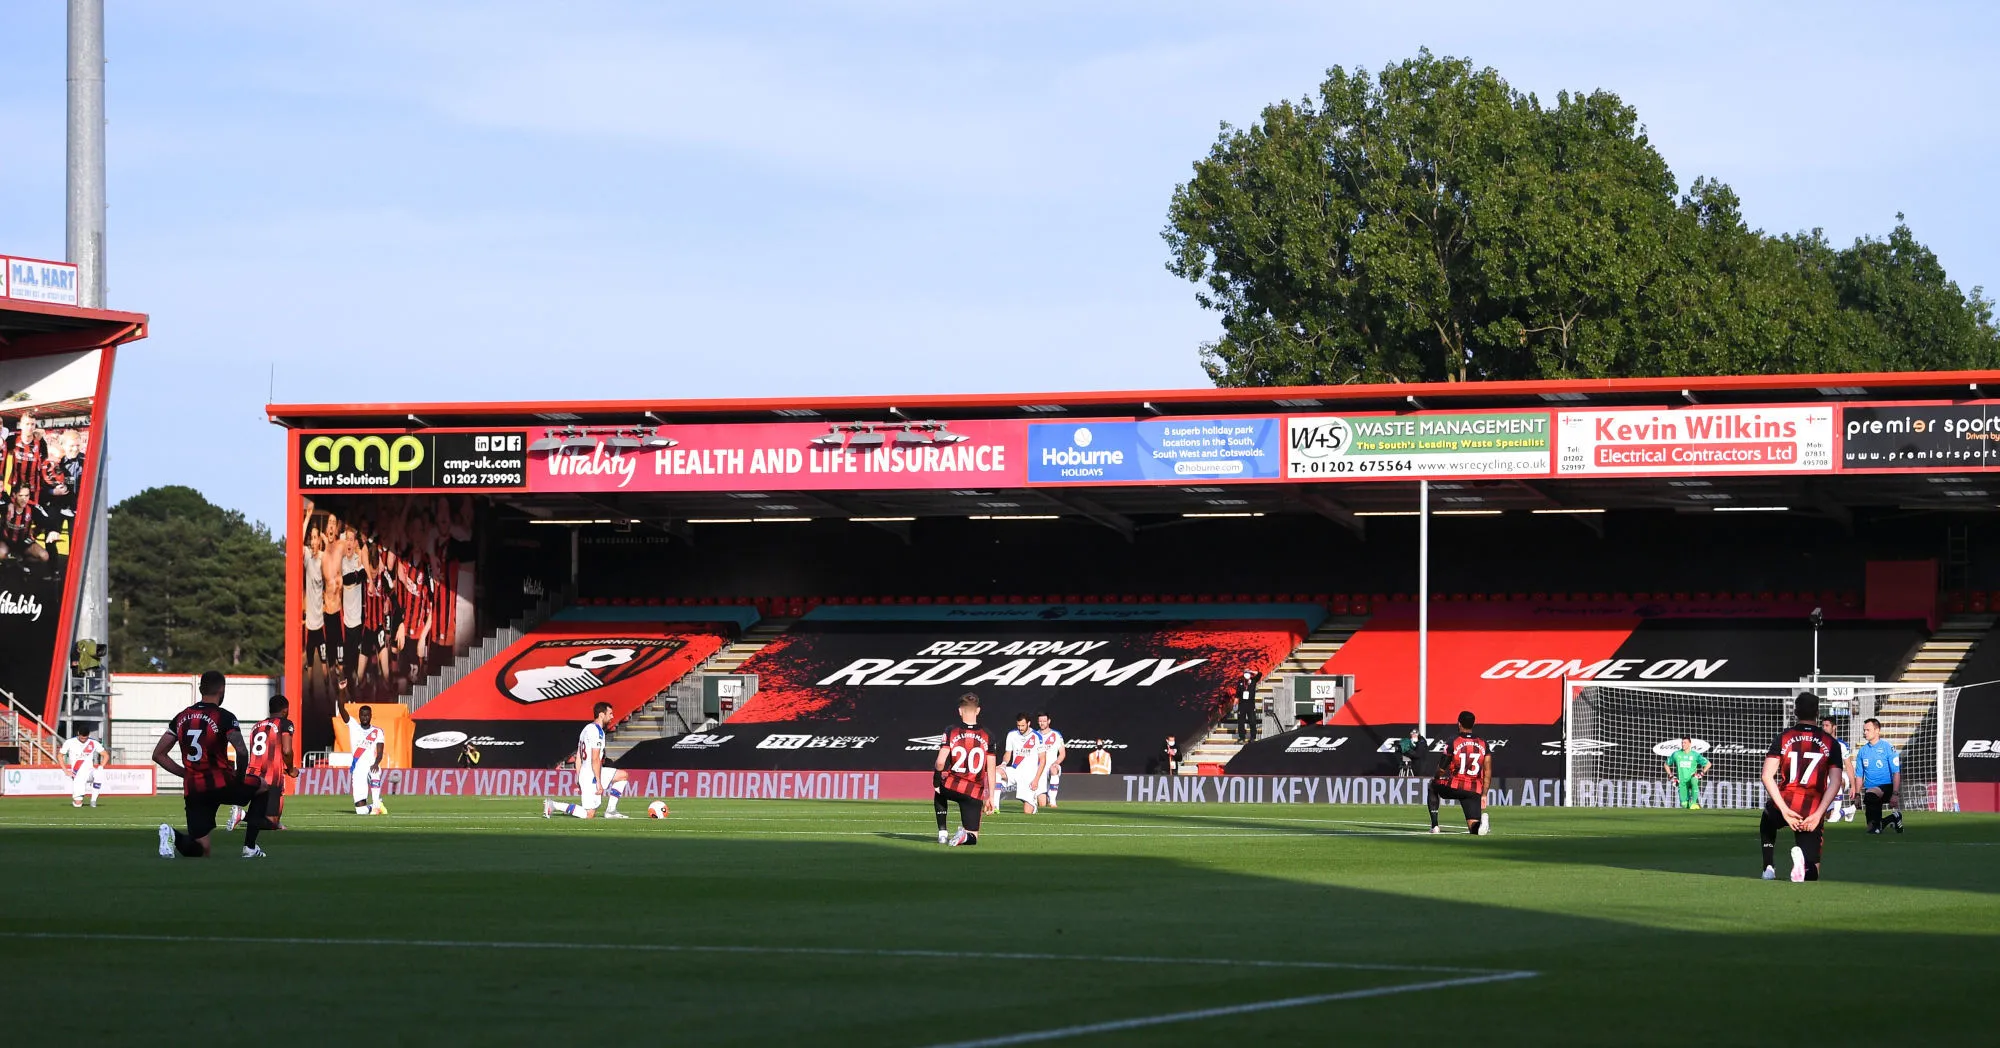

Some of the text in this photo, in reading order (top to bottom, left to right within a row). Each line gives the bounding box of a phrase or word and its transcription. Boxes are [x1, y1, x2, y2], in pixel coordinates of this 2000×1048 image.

[12, 263, 39, 286] M.A.
[41, 267, 75, 290] HART
[1164, 425, 1254, 438] 8 superb holiday park
[1354, 418, 1546, 437] WASTE MANAGEMENT
[1595, 413, 1796, 441] Kevin Wilkins
[1847, 416, 1936, 441] premier
[1965, 432, 1989, 441] Driven
[1163, 437, 1255, 448] locations in the South,
[1290, 427, 1342, 449] W+S
[1356, 438, 1545, 452] The South's Leading Waste Specialist
[305, 435, 425, 486] cmp
[654, 444, 1005, 475] HEALTH AND LIFE INSURANCE
[1042, 446, 1124, 465] Hoburne
[1153, 448, 1265, 459] South West and Cotswolds.
[1600, 445, 1793, 463] Electrical Contractors Ltd
[443, 456, 521, 472] cmp-uk.com
[547, 441, 636, 488] Vitality
[1061, 467, 1104, 477] HOLIDAYS
[1291, 458, 1546, 473] T: 01202 675564 www.wsrecycling.co.uk
[306, 473, 389, 486] Print Solutions
[443, 472, 521, 486] 01202 739993
[947, 609, 1162, 618] Premier League
[572, 638, 681, 648] BOURNEMOUTH
[916, 640, 1110, 656] RED ARMY
[816, 658, 1209, 686] RED ARMY
[1480, 659, 1729, 679] COME ON
[1316, 685, 1331, 695] SV2
[186, 729, 203, 762] 3
[252, 731, 268, 756] 8
[676, 734, 736, 745] BU
[804, 739, 868, 749] BET
[1288, 737, 1349, 748] BU
[1781, 736, 1796, 755] BLACK
[1812, 738, 1830, 757] MATTER
[951, 745, 985, 774] 20
[1459, 752, 1481, 776] 13
[1787, 751, 1824, 785] 17
[294, 769, 353, 796] THAN
[424, 769, 469, 796] KEY
[644, 771, 689, 798] AFC
[696, 771, 880, 800] BOURNEMOUTH
[1123, 776, 1206, 803] THANK
[1213, 776, 1268, 803] YOU
[1273, 777, 1320, 804] KEY
[1326, 777, 1438, 805] WORKE
[1579, 780, 1767, 809] BOURNMOUT
